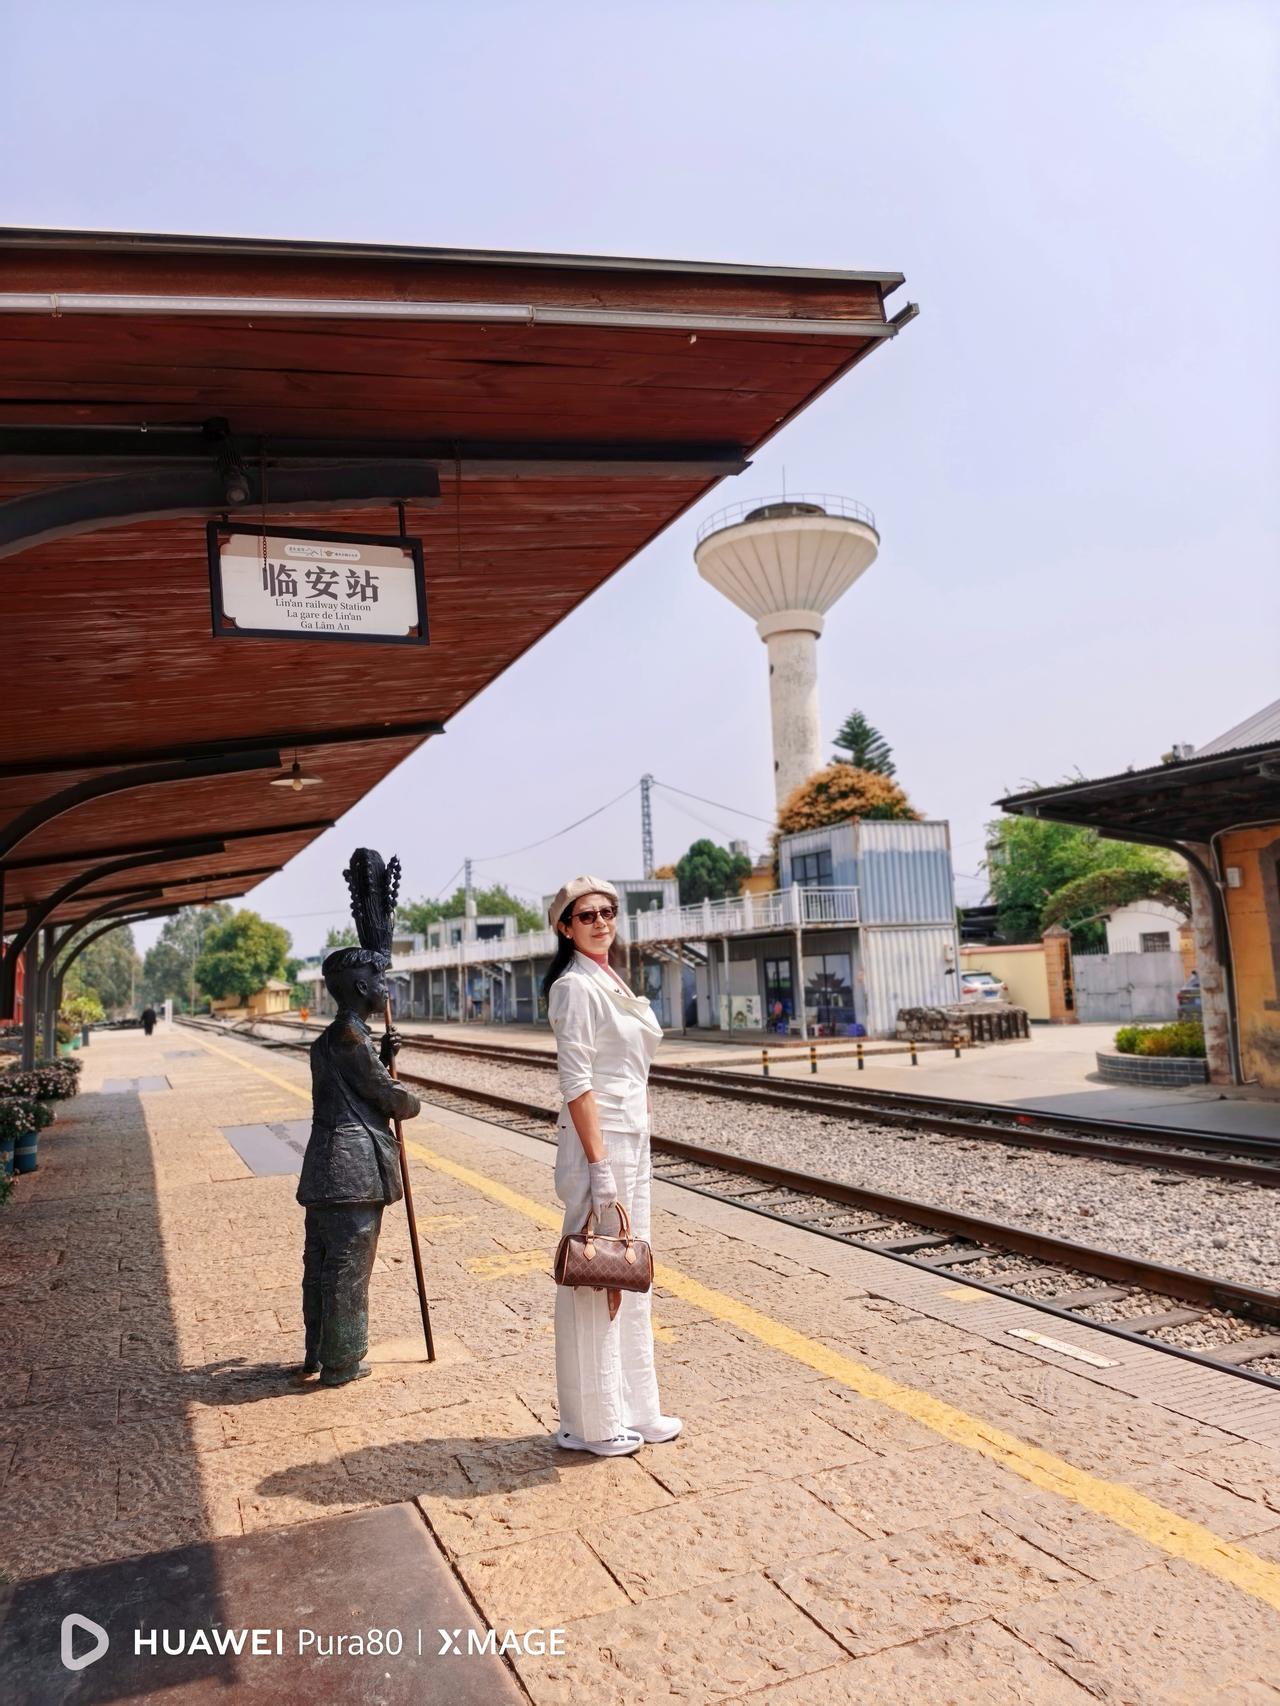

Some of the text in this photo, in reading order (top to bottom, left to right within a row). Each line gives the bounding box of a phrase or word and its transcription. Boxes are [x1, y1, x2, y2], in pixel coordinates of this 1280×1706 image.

[262, 563, 379, 603] 临安站
[275, 598, 371, 611] Lin'an railway Station
[287, 609, 362, 621] La gare de Lin'an
[300, 620, 350, 631] Ga Lâm An
